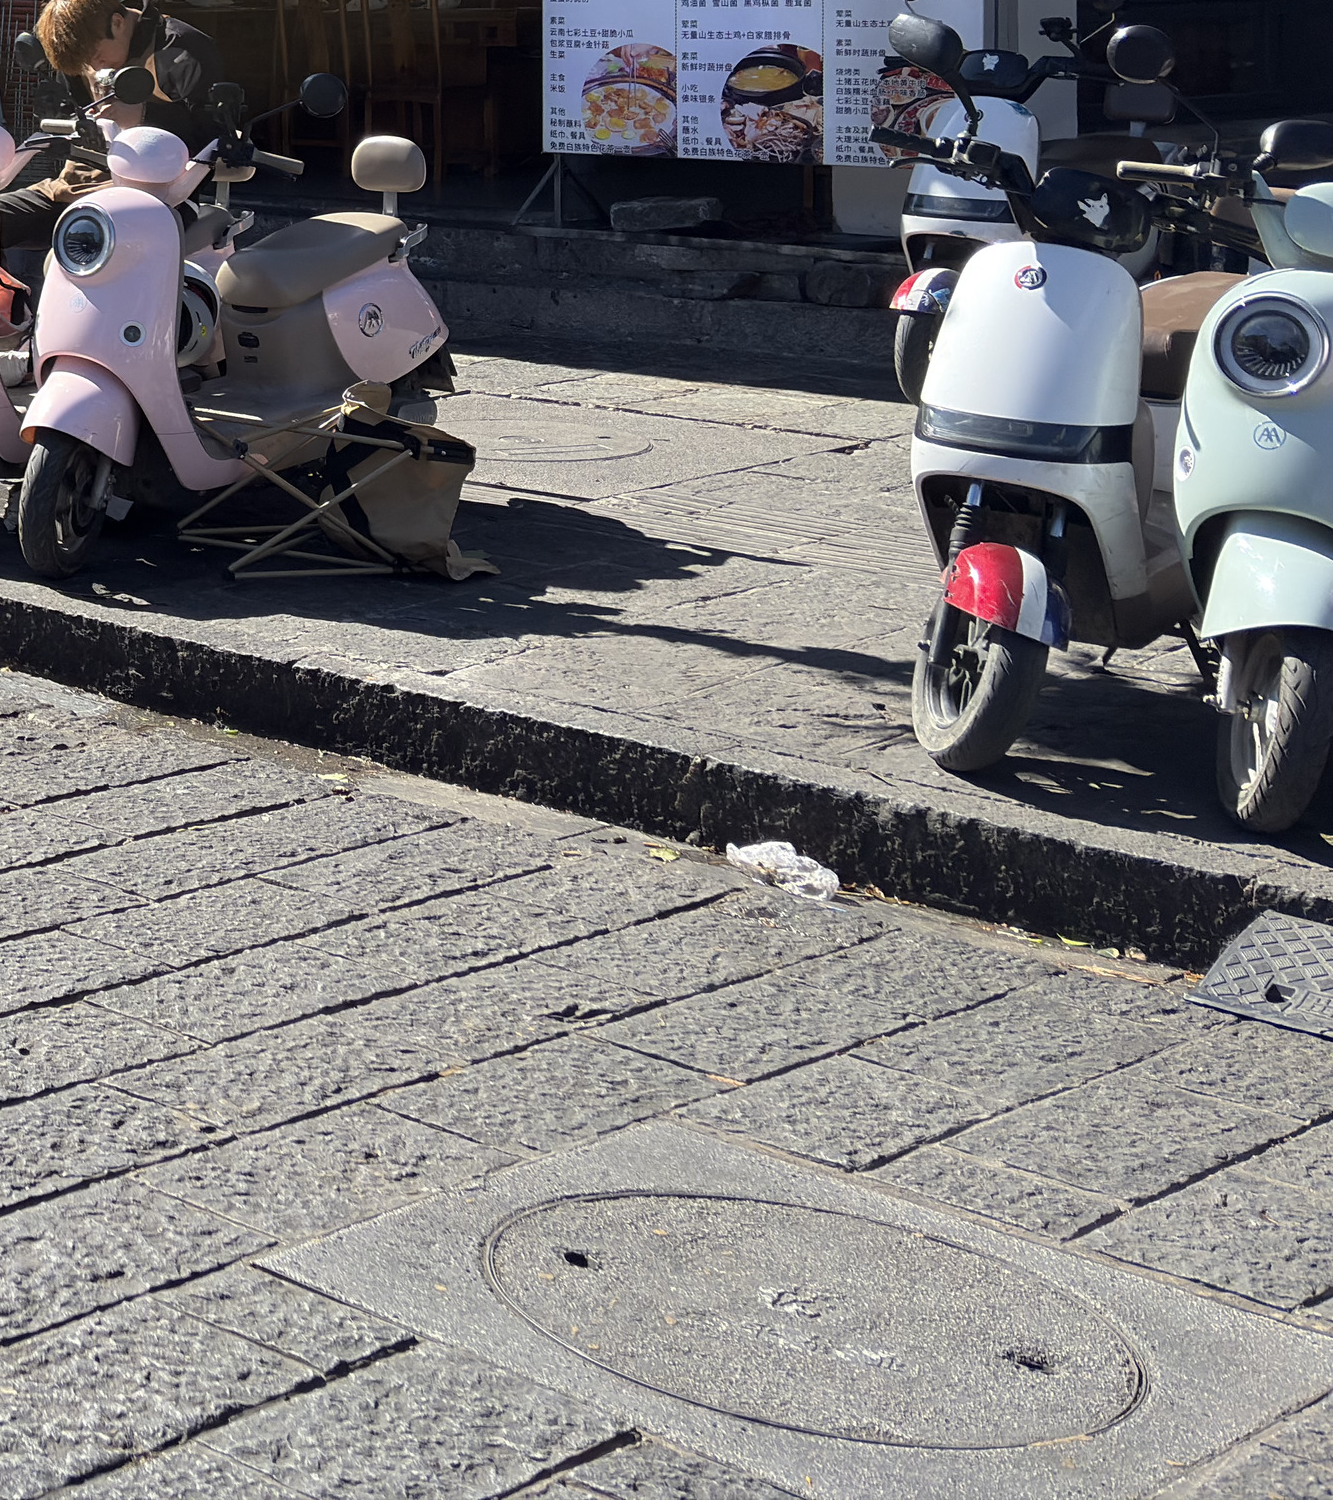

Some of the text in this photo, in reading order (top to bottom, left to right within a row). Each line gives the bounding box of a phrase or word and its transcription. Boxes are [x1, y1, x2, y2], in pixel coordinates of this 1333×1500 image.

[549, 28, 634, 38] 云南七彩土豆+甜脆小瓜
[549, 50, 565, 59] 生菜
[835, 68, 861, 77] 烧烤类
[549, 73, 565, 82] 主食
[549, 84, 566, 93] 米饭
[681, 84, 699, 93] 小吃
[549, 107, 566, 116] 其他
[682, 115, 699, 124] 其他
